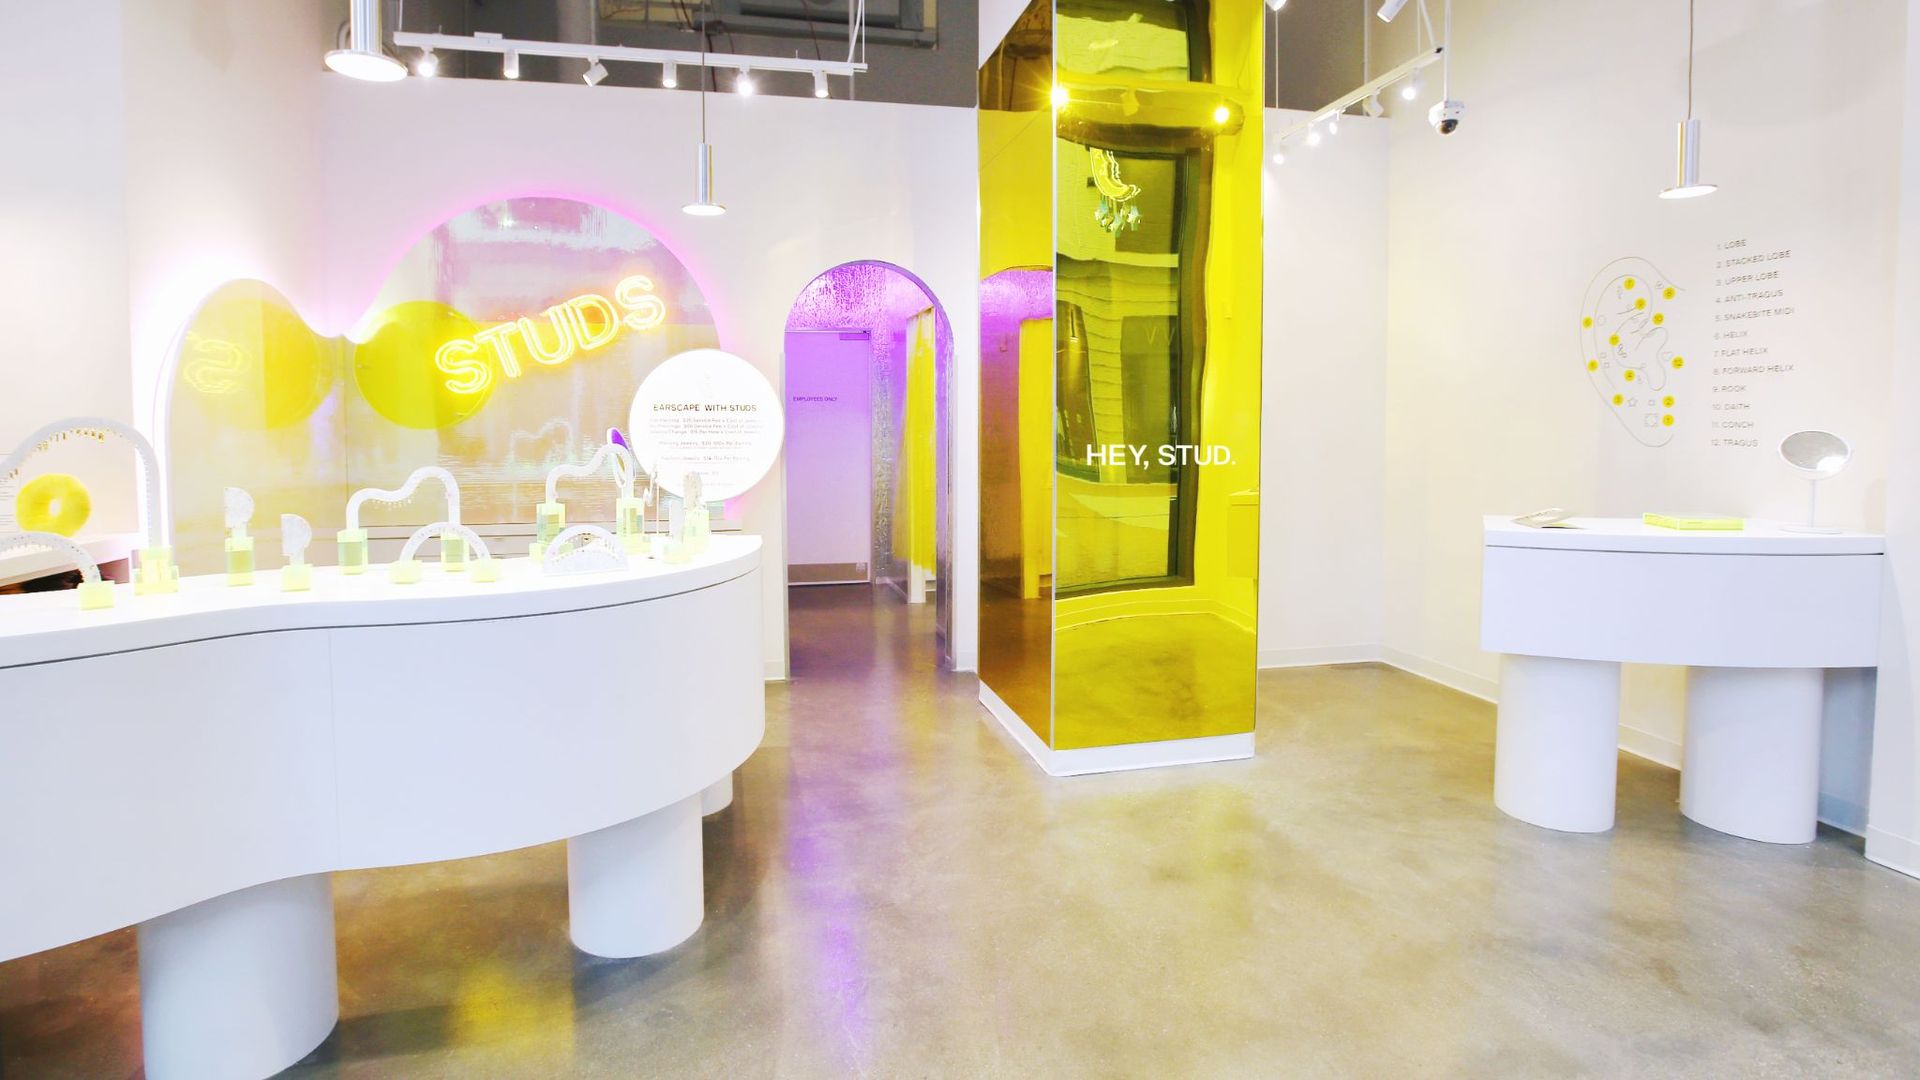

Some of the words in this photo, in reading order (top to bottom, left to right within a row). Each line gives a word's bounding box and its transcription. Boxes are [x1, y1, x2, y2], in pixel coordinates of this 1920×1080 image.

[1724, 239, 1747, 250] LOBE
[1725, 254, 1765, 268] STACKED
[1766, 250, 1792, 261] LOBE
[1725, 274, 1753, 286] UPPER
[1755, 270, 1779, 282] LOBE
[1724, 289, 1784, 303] ANTI-TRAGUS
[1723, 309, 1772, 321] SNAKEBITE
[1774, 307, 1795, 316] MIDI
[435, 275, 666, 394] STUDS
[1723, 331, 1748, 339] HELIX
[1721, 348, 1740, 357] FLAT
[1743, 347, 1768, 356] HELIX
[1721, 365, 1765, 375] FORWARD
[1767, 364, 1794, 373] HELIX
[1721, 385, 1747, 393] ROOK
[653, 403, 700, 412] EARSCAPE
[704, 404, 727, 412] WITH
[729, 404, 757, 412] STUDS
[1724, 403, 1751, 411] DAITH
[1723, 439, 1758, 448] TRAGUS
[1086, 443, 1148, 470] HEY,
[1158, 443, 1236, 466] STUD.
